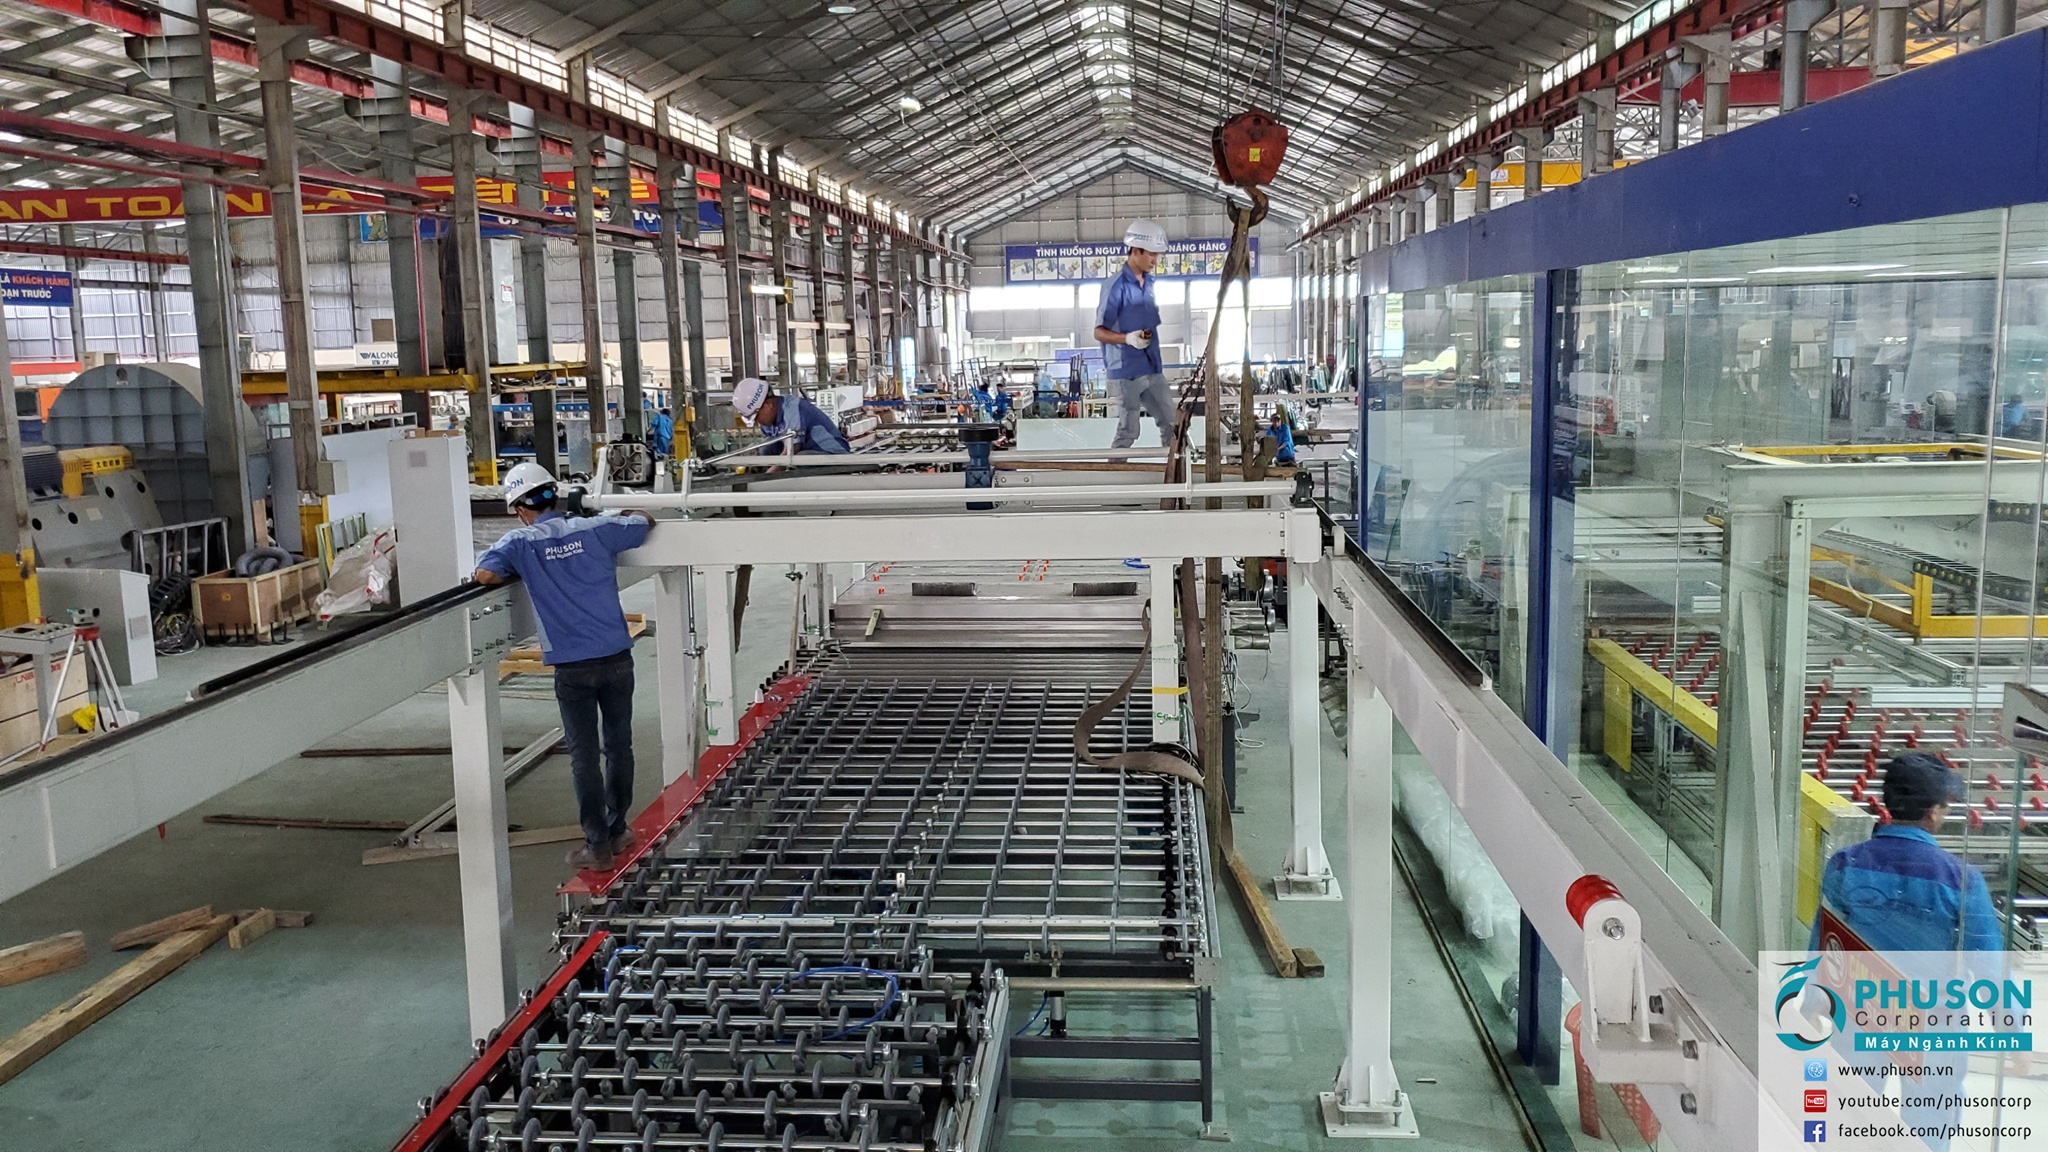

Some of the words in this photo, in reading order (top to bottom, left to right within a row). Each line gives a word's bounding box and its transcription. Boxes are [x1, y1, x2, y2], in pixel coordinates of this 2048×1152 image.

[1036, 247, 1057, 257] TÌNH
[1095, 247, 1122, 255] NGUY
[1198, 241, 1227, 251] HÀNG
[747, 383, 764, 410] PHUSON
[545, 540, 583, 555] PHUSON
